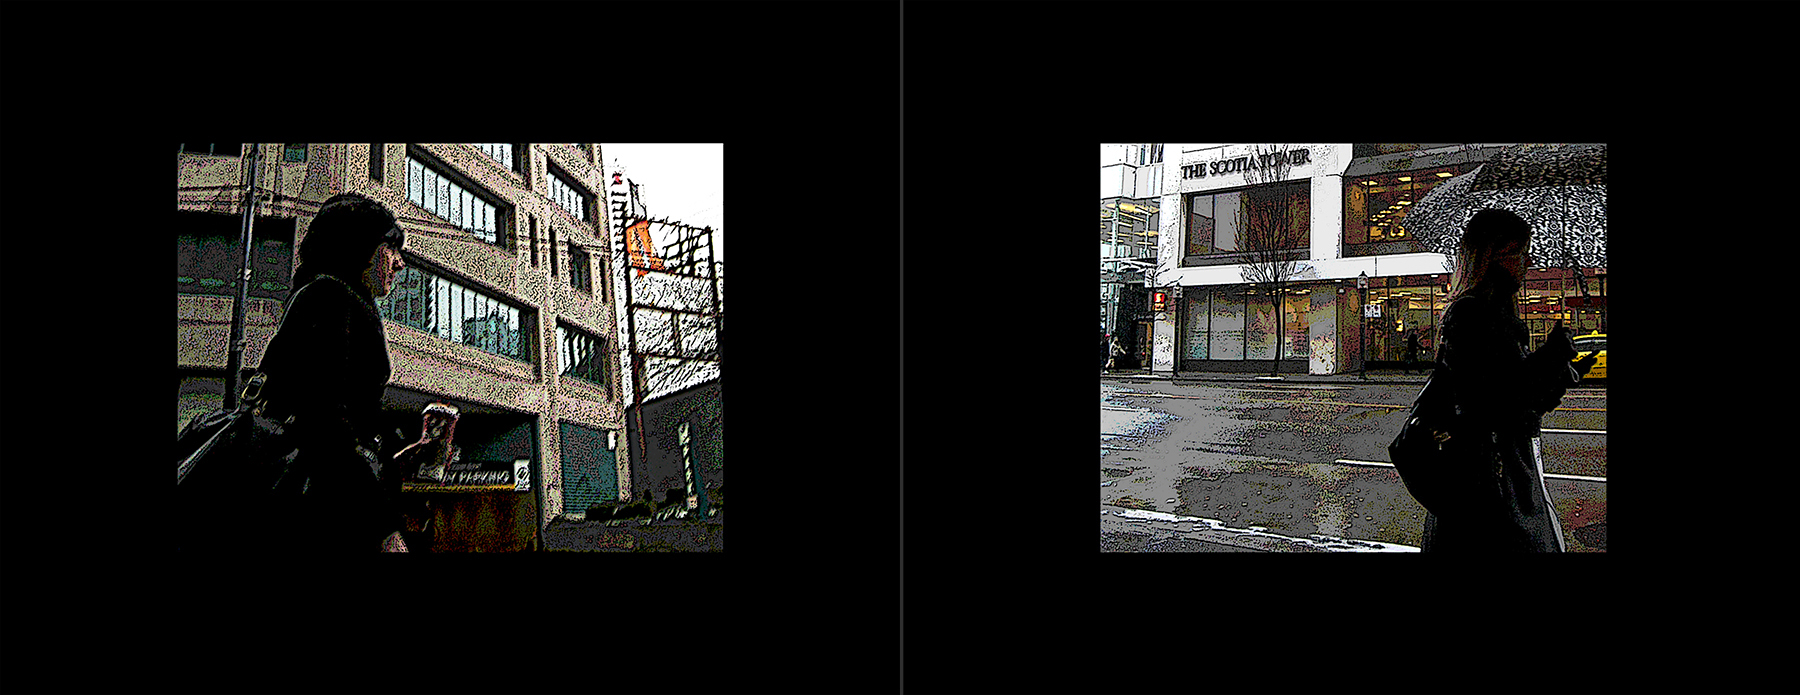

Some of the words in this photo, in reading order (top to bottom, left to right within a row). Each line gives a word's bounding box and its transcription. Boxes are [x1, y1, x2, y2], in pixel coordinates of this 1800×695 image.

[1181, 163, 1207, 179] THE
[1209, 154, 1257, 176] SCOTIA
[1258, 148, 1312, 169] TOWER
